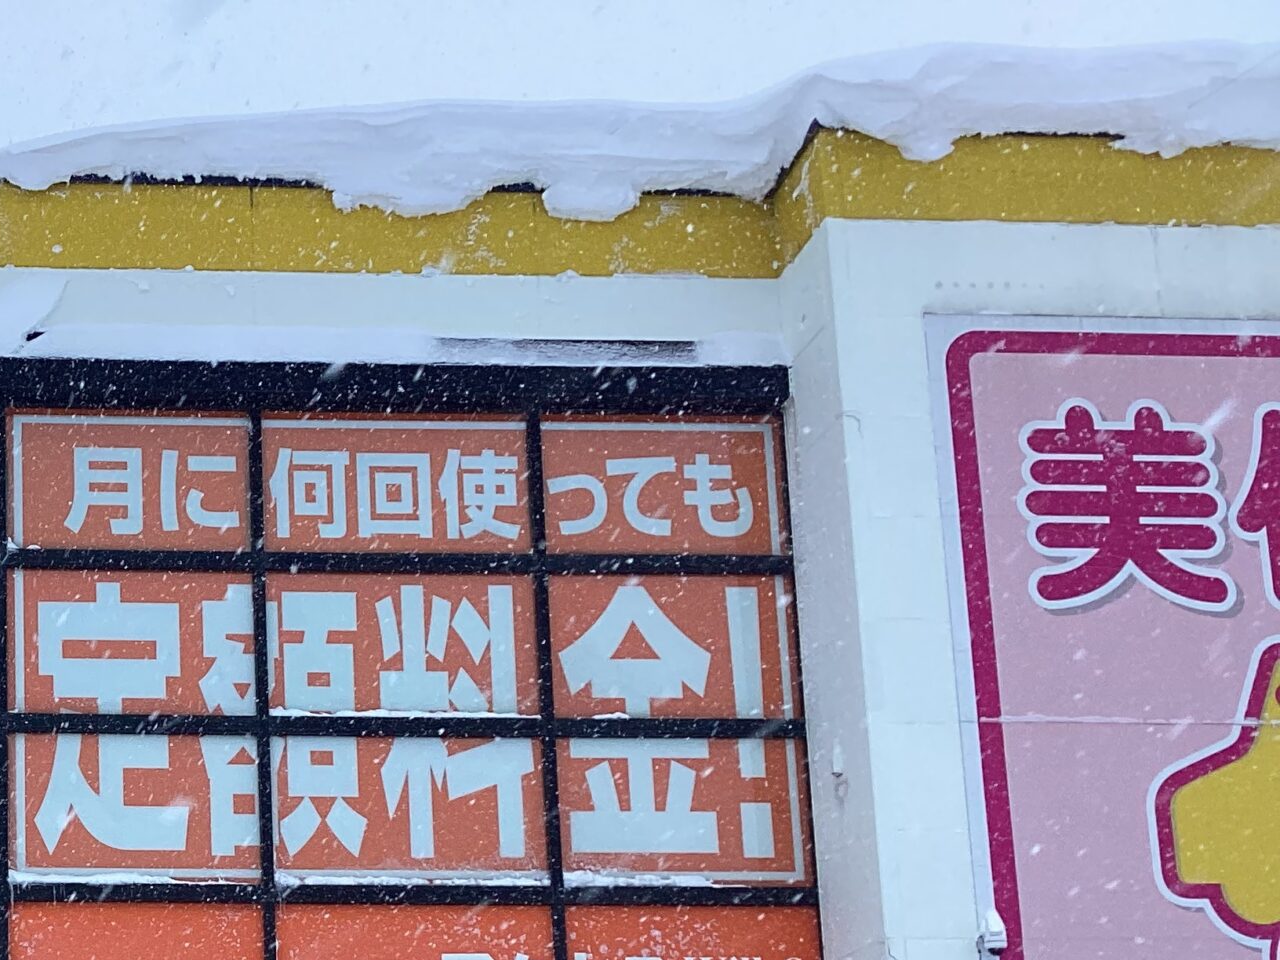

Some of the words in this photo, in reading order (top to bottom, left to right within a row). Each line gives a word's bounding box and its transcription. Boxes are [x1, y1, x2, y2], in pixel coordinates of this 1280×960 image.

[63, 446, 754, 541] 月に何回使っても
